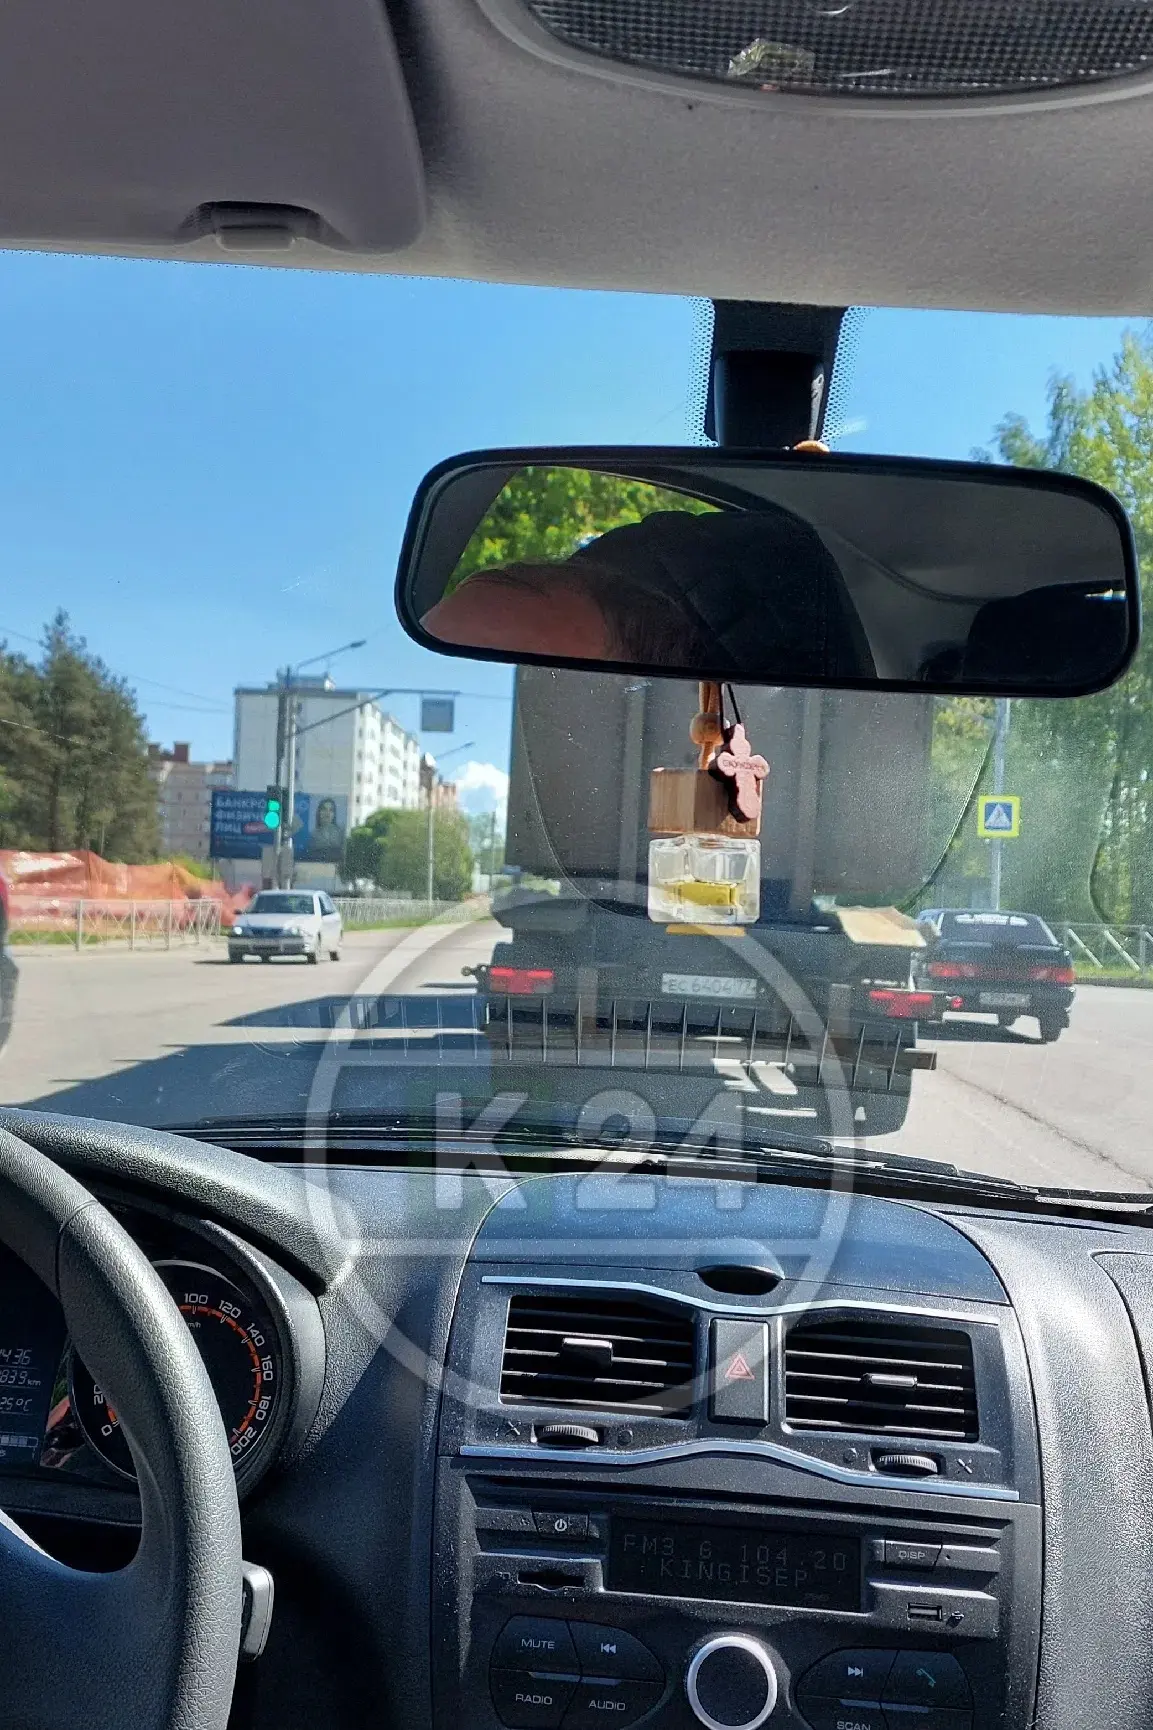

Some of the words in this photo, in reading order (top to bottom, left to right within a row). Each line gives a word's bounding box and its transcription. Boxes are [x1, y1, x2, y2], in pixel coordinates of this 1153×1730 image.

[184, 1293, 208, 1305] 100
[218, 1299, 242, 1319] 120
[246, 1323, 266, 1347] 140
[0, 1348, 32, 1365] 436
[261, 1354, 274, 1381] 160
[93, 1384, 104, 1406] 20
[255, 1395, 272, 1421] 180
[101, 1424, 113, 1436] 0
[230, 1426, 258, 1456] 200
[623, 1534, 674, 1556] FM3
[898, 1550, 926, 1560] DISP
[521, 1638, 556, 1650] MUTE
[515, 1693, 553, 1706] RADIO
[588, 1699, 627, 1712] AUDIO
[836, 1720, 871, 1730] SCAN
